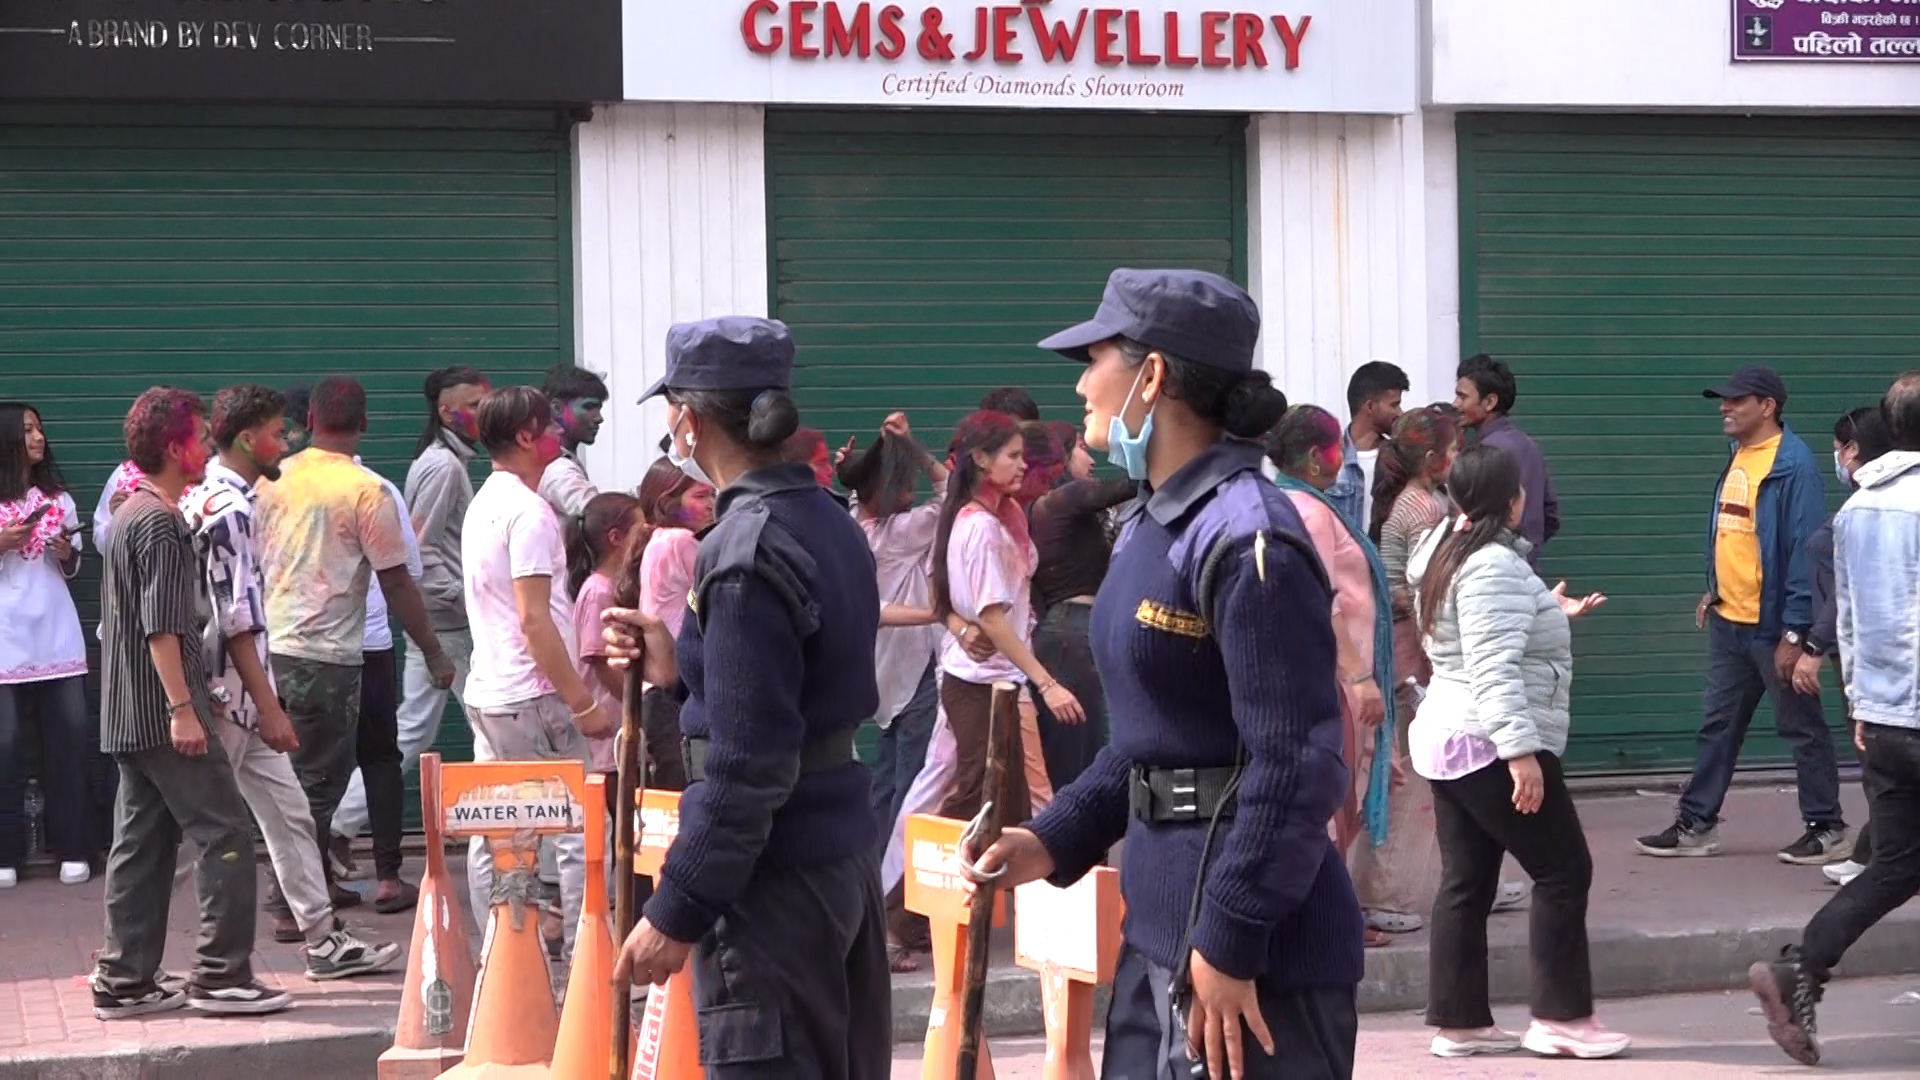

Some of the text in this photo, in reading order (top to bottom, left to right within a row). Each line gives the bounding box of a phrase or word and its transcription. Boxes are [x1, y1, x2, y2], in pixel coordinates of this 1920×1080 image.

[68, 20, 373, 51] A BRAND BY DEV CORNER
[1792, 31, 1920, 54] पहिलो तल्ल
[882, 73, 1185, 99] Certified Diamonds Showroom
[455, 806, 518, 820] WATER
